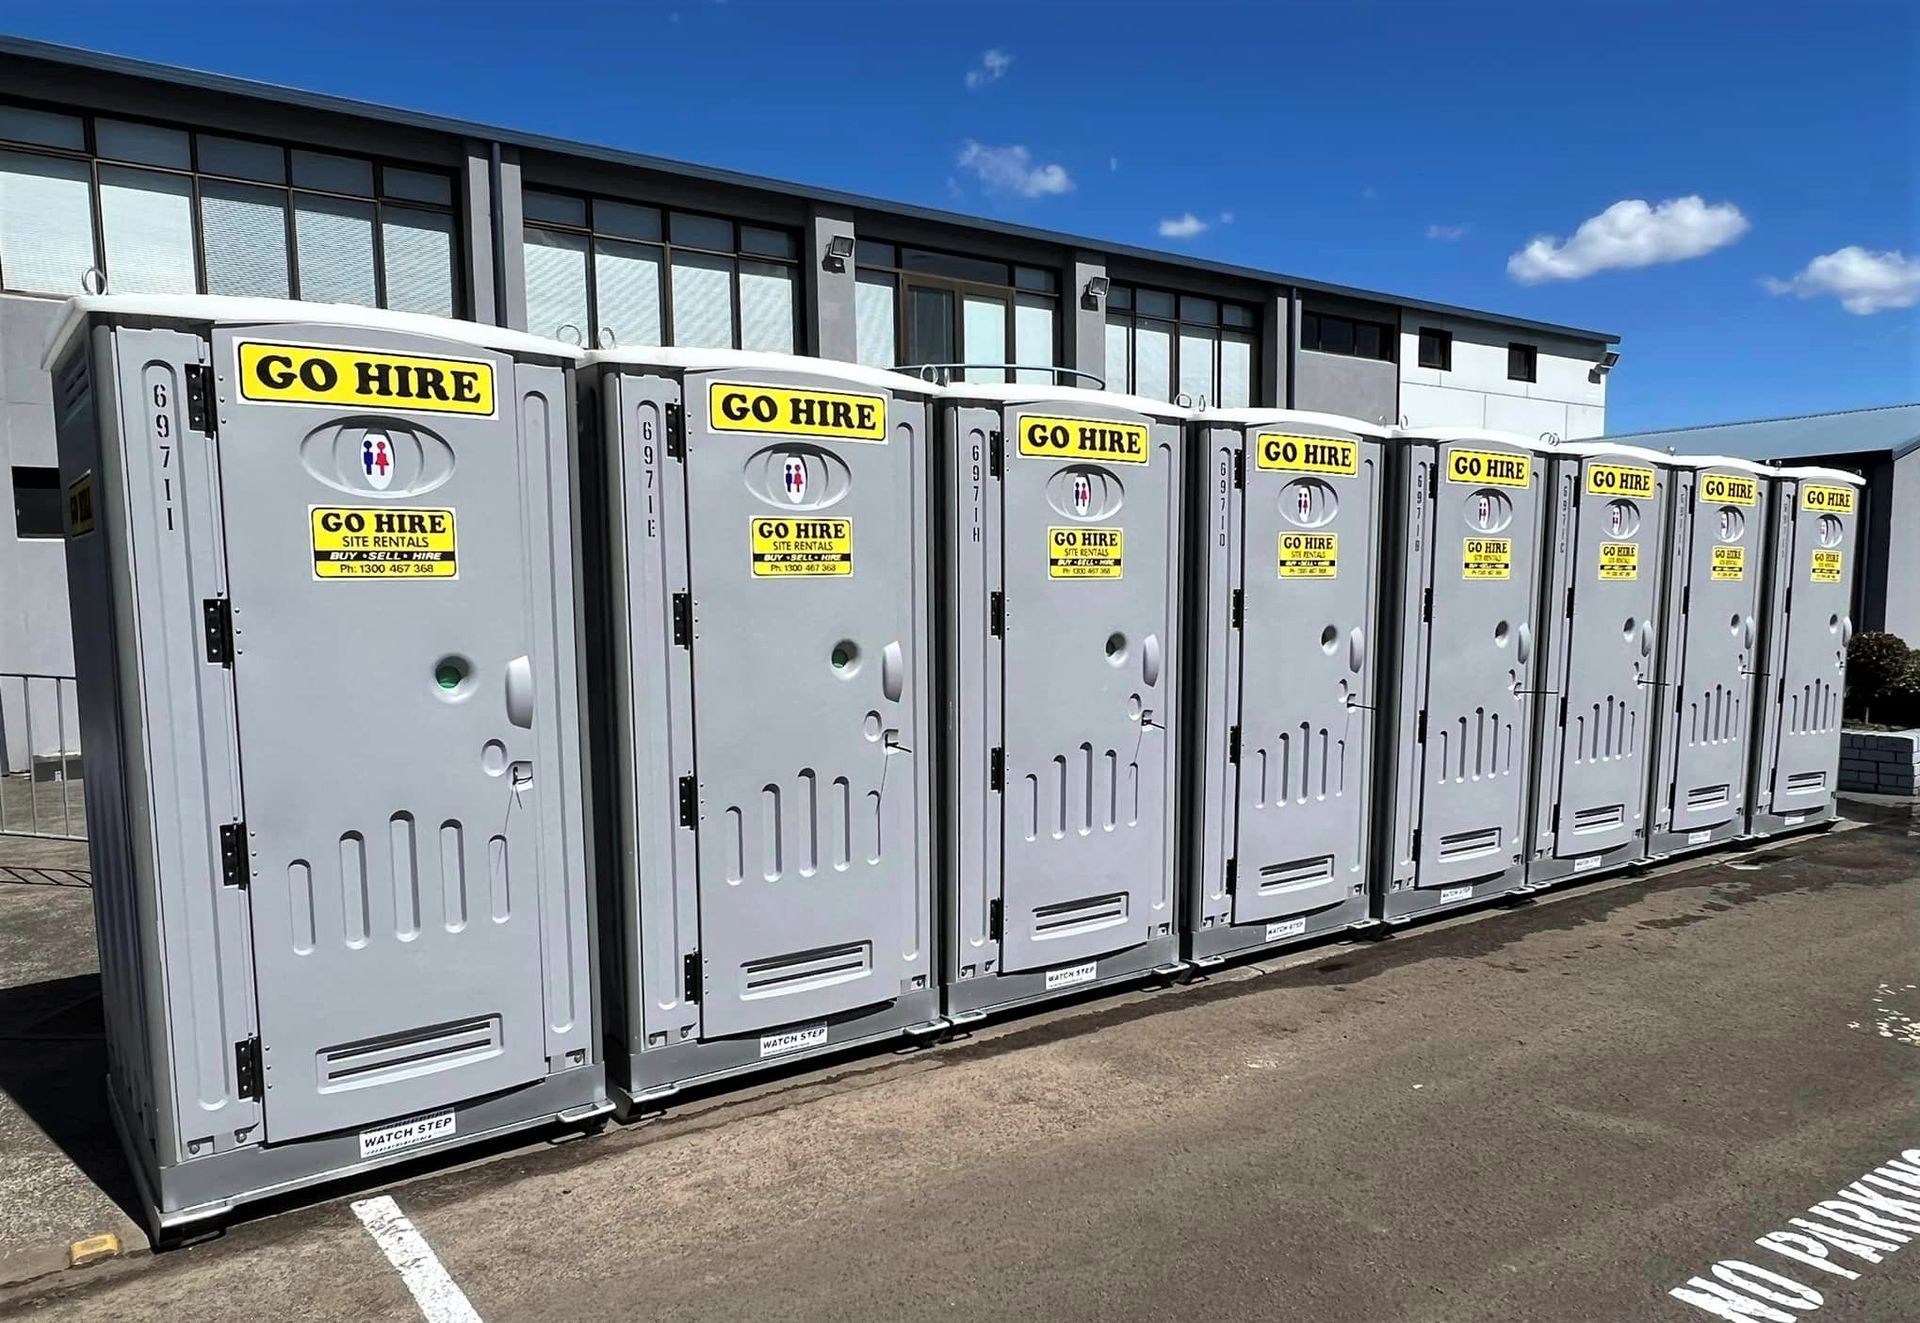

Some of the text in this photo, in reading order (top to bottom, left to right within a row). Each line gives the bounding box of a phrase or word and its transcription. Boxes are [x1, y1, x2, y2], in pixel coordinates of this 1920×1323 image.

[256, 354, 481, 404] GO HIRE
[721, 392, 876, 431] GO HIRE
[1027, 423, 1141, 454] GO HIRE
[1264, 441, 1352, 467] GO HIRE
[1454, 456, 1525, 480] GO HIRE
[1593, 471, 1651, 491] GO HIRE
[1706, 480, 1753, 500] GO HIRE
[1807, 490, 1851, 508] GO HIRE
[321, 512, 447, 534] GO HIRE
[758, 522, 846, 539] GO HIRE
[342, 535, 430, 548] SITE RENTALS
[773, 541, 834, 552] SITE RENTALS
[1054, 531, 1118, 547] GO HIRE
[1284, 536, 1334, 550] GO HIRE
[1468, 541, 1508, 554] GO HIRE
[329, 551, 359, 561] BUY
[412, 551, 443, 561] HIRE
[1603, 546, 1636, 557] GO HIRE
[340, 563, 435, 574] Ph: 1300 467 368
[763, 1034, 798, 1049] WATCH
[800, 1028, 825, 1041] STEP
[364, 1126, 414, 1148] WATCH
[417, 1117, 453, 1134] STEP
[1668, 1149, 1920, 1323] NO PARKI
